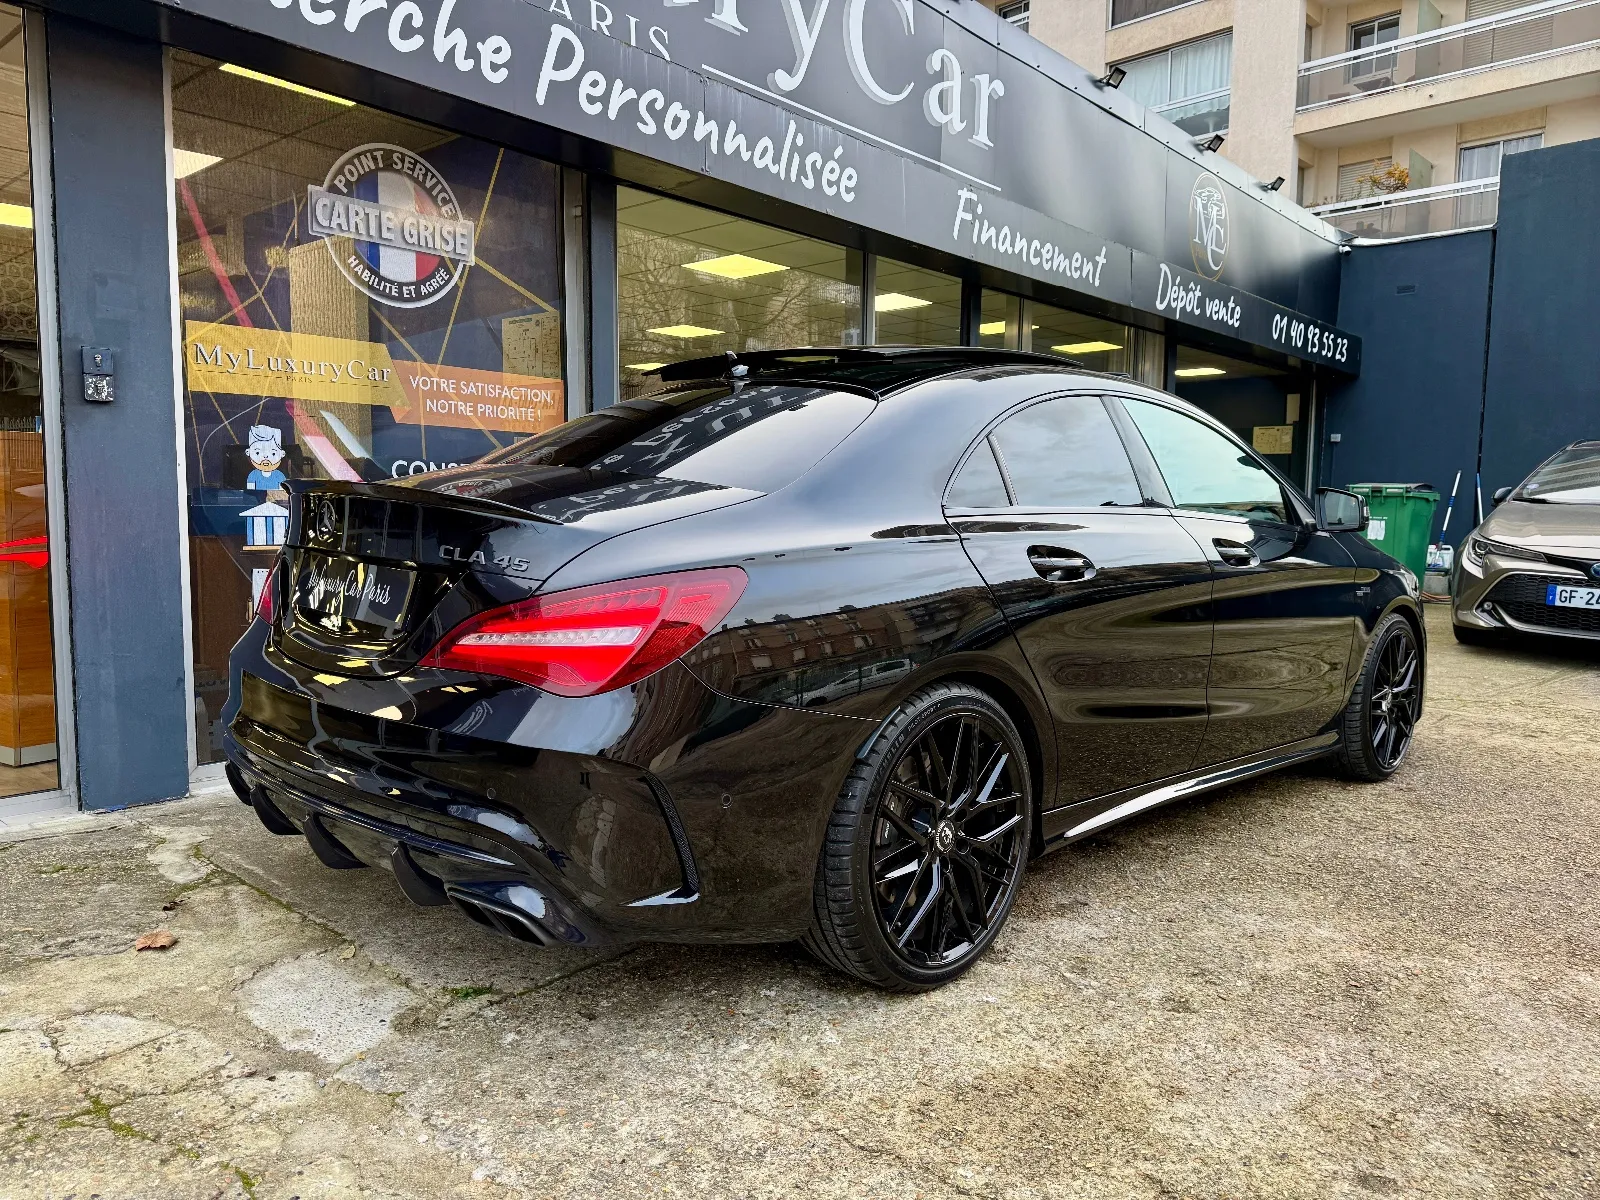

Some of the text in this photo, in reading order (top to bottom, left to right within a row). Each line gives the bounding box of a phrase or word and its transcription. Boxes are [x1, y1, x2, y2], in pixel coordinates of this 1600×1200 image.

[535, 23, 858, 203] Personnalisée
[333, 150, 457, 218] POINT SERVICE
[315, 197, 469, 255] CARTE GRISE
[952, 187, 1107, 287] Financement
[347, 254, 450, 298] HABILITÉ ET AGRÉÉ
[1155, 262, 1241, 328] Dépôt vente
[1272, 313, 1348, 363] 01 40 93 55 23
[193, 342, 391, 382] MyLuxuryCar
[286, 374, 313, 384] PARIS
[409, 374, 554, 405] VOTRE SATISFACTION,
[426, 398, 474, 416] NOTRE
[477, 404, 534, 422] PRIORITÉ
[439, 544, 530, 573] CLA 45
